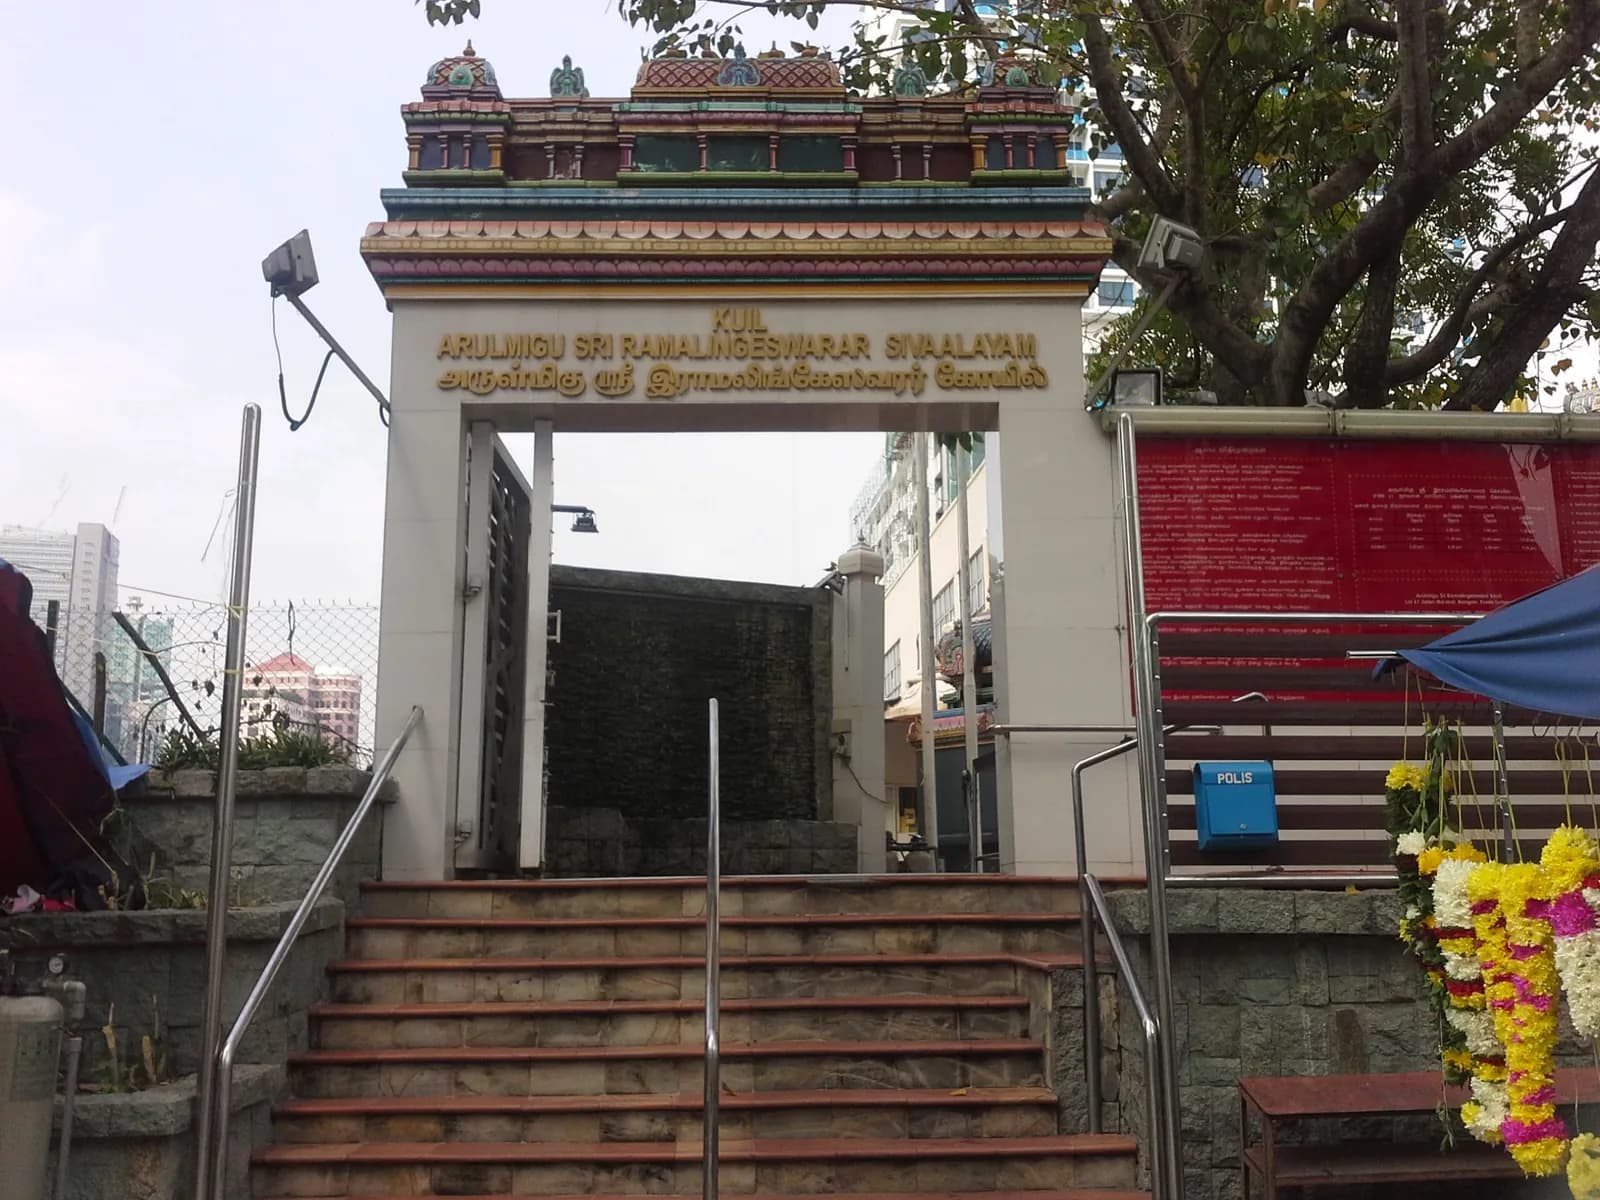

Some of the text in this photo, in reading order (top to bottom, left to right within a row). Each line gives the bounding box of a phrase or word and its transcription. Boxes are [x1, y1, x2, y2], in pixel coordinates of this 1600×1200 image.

[712, 306, 769, 333] KUIL
[438, 333, 1037, 360] ARULMIGU SRI RAMALINGESWARAR SIVAALAYAM
[437, 361, 586, 396] அருள்மிகு
[935, 360, 1049, 389] கோயில்
[1217, 772, 1253, 784] POLIS
